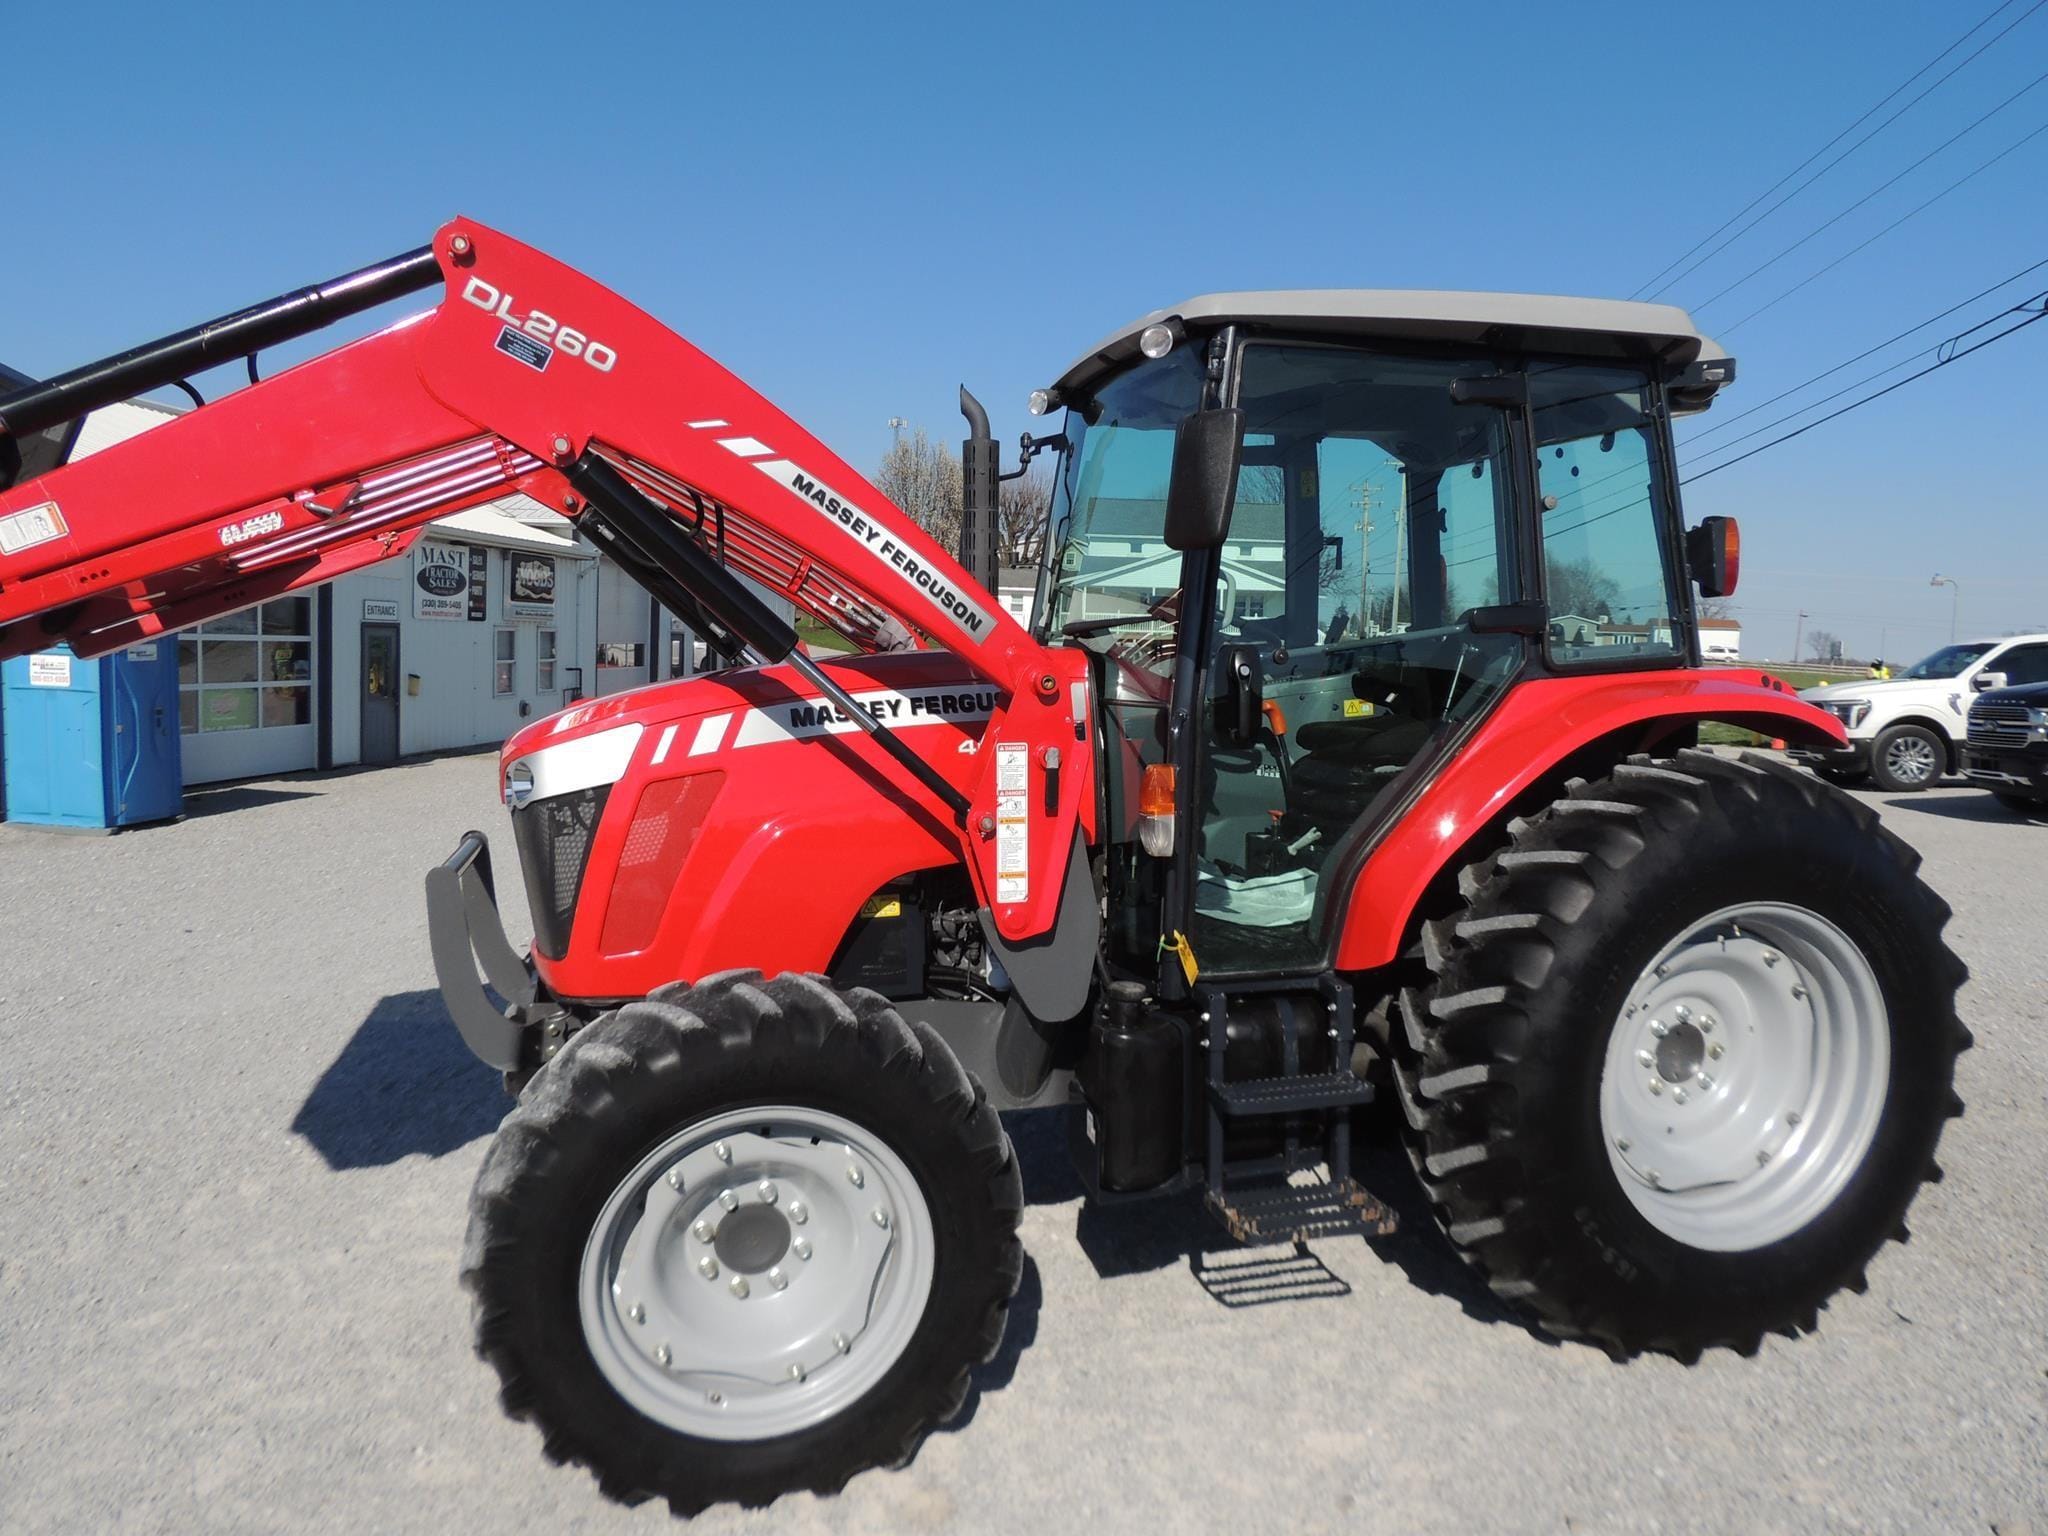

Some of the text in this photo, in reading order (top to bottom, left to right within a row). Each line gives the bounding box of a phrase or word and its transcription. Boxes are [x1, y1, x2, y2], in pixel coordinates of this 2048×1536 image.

[462, 275, 617, 372] DL260
[421, 546, 465, 568] MAST
[791, 473, 983, 633] MASSEY FERGUSON
[425, 565, 459, 580] TRACTOR
[429, 577, 457, 589] SALES
[367, 604, 396, 617] ENTRANCE
